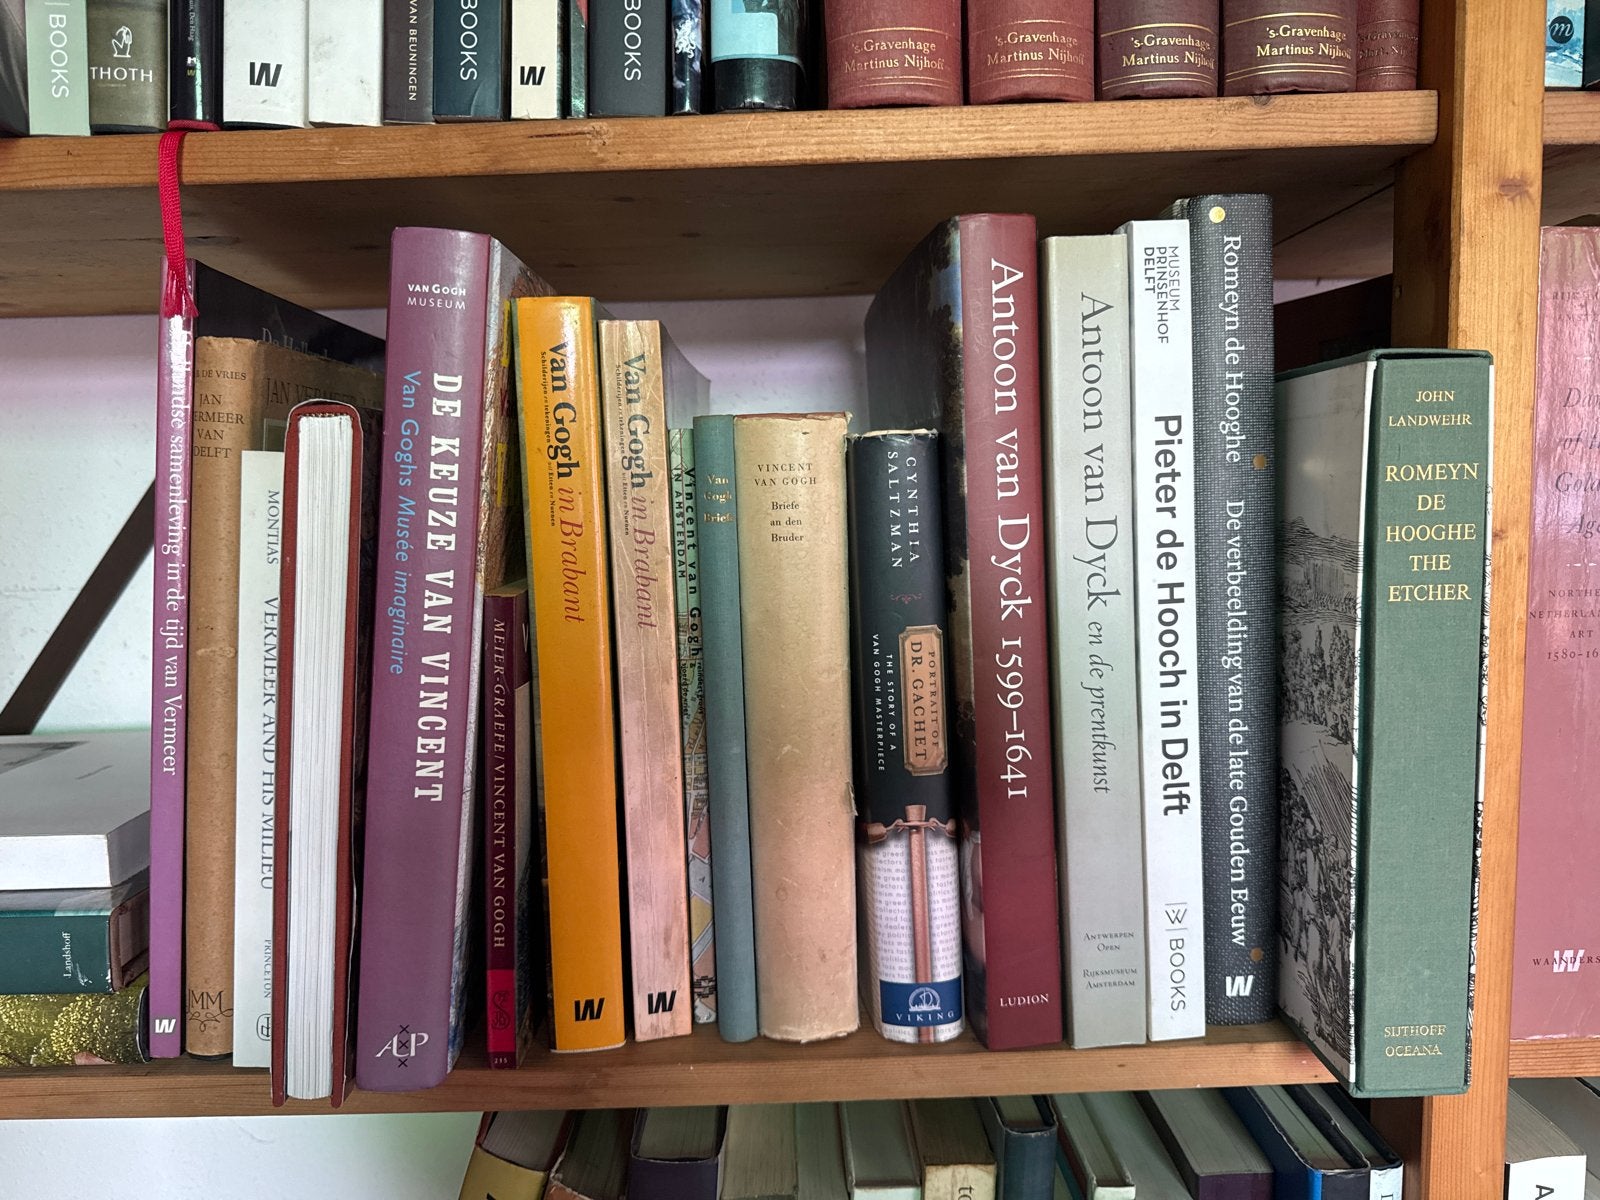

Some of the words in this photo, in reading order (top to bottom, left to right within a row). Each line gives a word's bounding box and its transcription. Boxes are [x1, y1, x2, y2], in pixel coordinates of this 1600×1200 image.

[47, 14, 69, 99] BOOKS
[408, 29, 418, 101] BEUNINGEN
[844, 57, 899, 73] Martinus
[987, 49, 1044, 66] Martinus
[1122, 53, 1180, 67] Martinus
[1256, 44, 1314, 58] Martinus
[89, 66, 153, 83] THOTH
[249, 61, 283, 88] W
[519, 65, 546, 86] W
[1144, 246, 1156, 293] DELFT
[1168, 246, 1180, 311] MUSEUM
[1218, 235, 1242, 332] Romeyn
[407, 283, 430, 293] VAN
[431, 283, 466, 296] GOGH
[407, 297, 466, 310] MUSEUM
[1156, 246, 1169, 343] PRINSENHOF
[991, 258, 1024, 415] Antoon
[1225, 336, 1245, 365] de
[216, 369, 247, 380] VRIES
[549, 341, 571, 393] Van
[623, 352, 647, 405] Van
[1081, 291, 1115, 433] Antoon
[200, 393, 222, 405] JAN
[401, 370, 422, 409] Van
[432, 372, 463, 418] DE
[1416, 390, 1456, 402] JOHN
[193, 410, 245, 425] ERMEER
[1219, 371, 1247, 463] Hooghe
[1388, 413, 1473, 427] LANDWEHR
[197, 429, 225, 440] VAN
[547, 401, 580, 479] Gogh
[1563, 429, 1587, 456] of
[394, 419, 419, 487] Goghs
[621, 414, 653, 489] Gogh
[757, 463, 813, 472] VINCENT
[995, 428, 1020, 500] van
[1154, 415, 1183, 519] Pieter
[706, 473, 729, 485] Van
[754, 478, 776, 486] VAN
[782, 477, 817, 485] GOGH
[1084, 443, 1105, 506] van
[1385, 463, 1480, 482] ROMEYN
[161, 435, 188, 556] samenleving
[426, 435, 460, 552] KEUZE
[558, 487, 582, 514] in
[631, 496, 655, 522] in
[684, 467, 698, 550] Vincent
[704, 490, 732, 503] Gogh
[771, 501, 800, 511] Briefe
[887, 451, 903, 568] SALTZMAN
[905, 456, 920, 562] CYNTHIA
[1417, 494, 1446, 511] DE
[266, 490, 280, 565] MONTIAS
[395, 495, 416, 562] Musée
[785, 517, 803, 526] den
[1226, 499, 1244, 530] De
[674, 490, 687, 578] AMSTERDAM
[771, 533, 804, 542] Bruder
[1156, 529, 1185, 570] de
[1385, 523, 1477, 543] HOOGHE
[167, 563, 186, 580] in
[559, 517, 587, 624] Brabant
[633, 527, 659, 629] Brabant
[687, 561, 698, 595] van
[991, 513, 1032, 621] Dyck
[1073, 515, 1121, 611] Dyck
[1409, 554, 1452, 572] THE
[166, 587, 185, 611] de
[422, 569, 455, 634] VAN
[1221, 535, 1248, 670] verbeelding
[1387, 583, 1473, 603] ETCHER
[387, 570, 412, 675] imaginaire
[1529, 608, 1600, 619] NETHERLA
[160, 619, 184, 649] tijd
[687, 606, 703, 657] Gogh
[872, 633, 880, 655] VAN
[1088, 621, 1103, 646] en
[1157, 582, 1187, 688] Hooch
[1569, 629, 1594, 639] ART
[164, 655, 178, 688] van
[886, 654, 894, 674] THE
[910, 641, 923, 673] DR.
[1089, 653, 1114, 680] de
[873, 661, 882, 692] GOGH
[928, 651, 939, 726] PORTRAIT
[1227, 673, 1242, 712] van
[887, 681, 896, 717] STORY
[1160, 700, 1188, 728] in
[162, 694, 183, 776] Vermeer
[414, 651, 450, 802] VINCENT
[875, 698, 885, 771] MASTERPIECE
[889, 723, 896, 737] OF
[911, 678, 927, 761] GACHET
[1228, 718, 1248, 746] de
[262, 713, 276, 764] AND
[931, 730, 940, 747] OF
[1081, 681, 1116, 794] prentkunst
[1161, 738, 1191, 816] Delft
[1229, 750, 1249, 791] late
[262, 771, 275, 806] HIS
[260, 813, 274, 890] MILIEU
[1229, 795, 1250, 883] Gouden
[493, 853, 505, 889] VAN
[493, 894, 505, 948] GOGH
[1231, 888, 1249, 947] Eeuw
[61, 931, 72, 978] Landshoff
[1532, 954, 1600, 967] WAANDERS
[1169, 938, 1186, 1011] BOOKS
[1225, 974, 1254, 997] W
[574, 997, 605, 1022] W
[647, 990, 677, 1015] W
[896, 1011, 955, 1022] VIKING
[1000, 993, 1049, 1007] LUDION
[155, 1019, 176, 1033] W
[1384, 1024, 1447, 1037] SIJTHOFF
[1385, 1044, 1443, 1057] OCEANA
